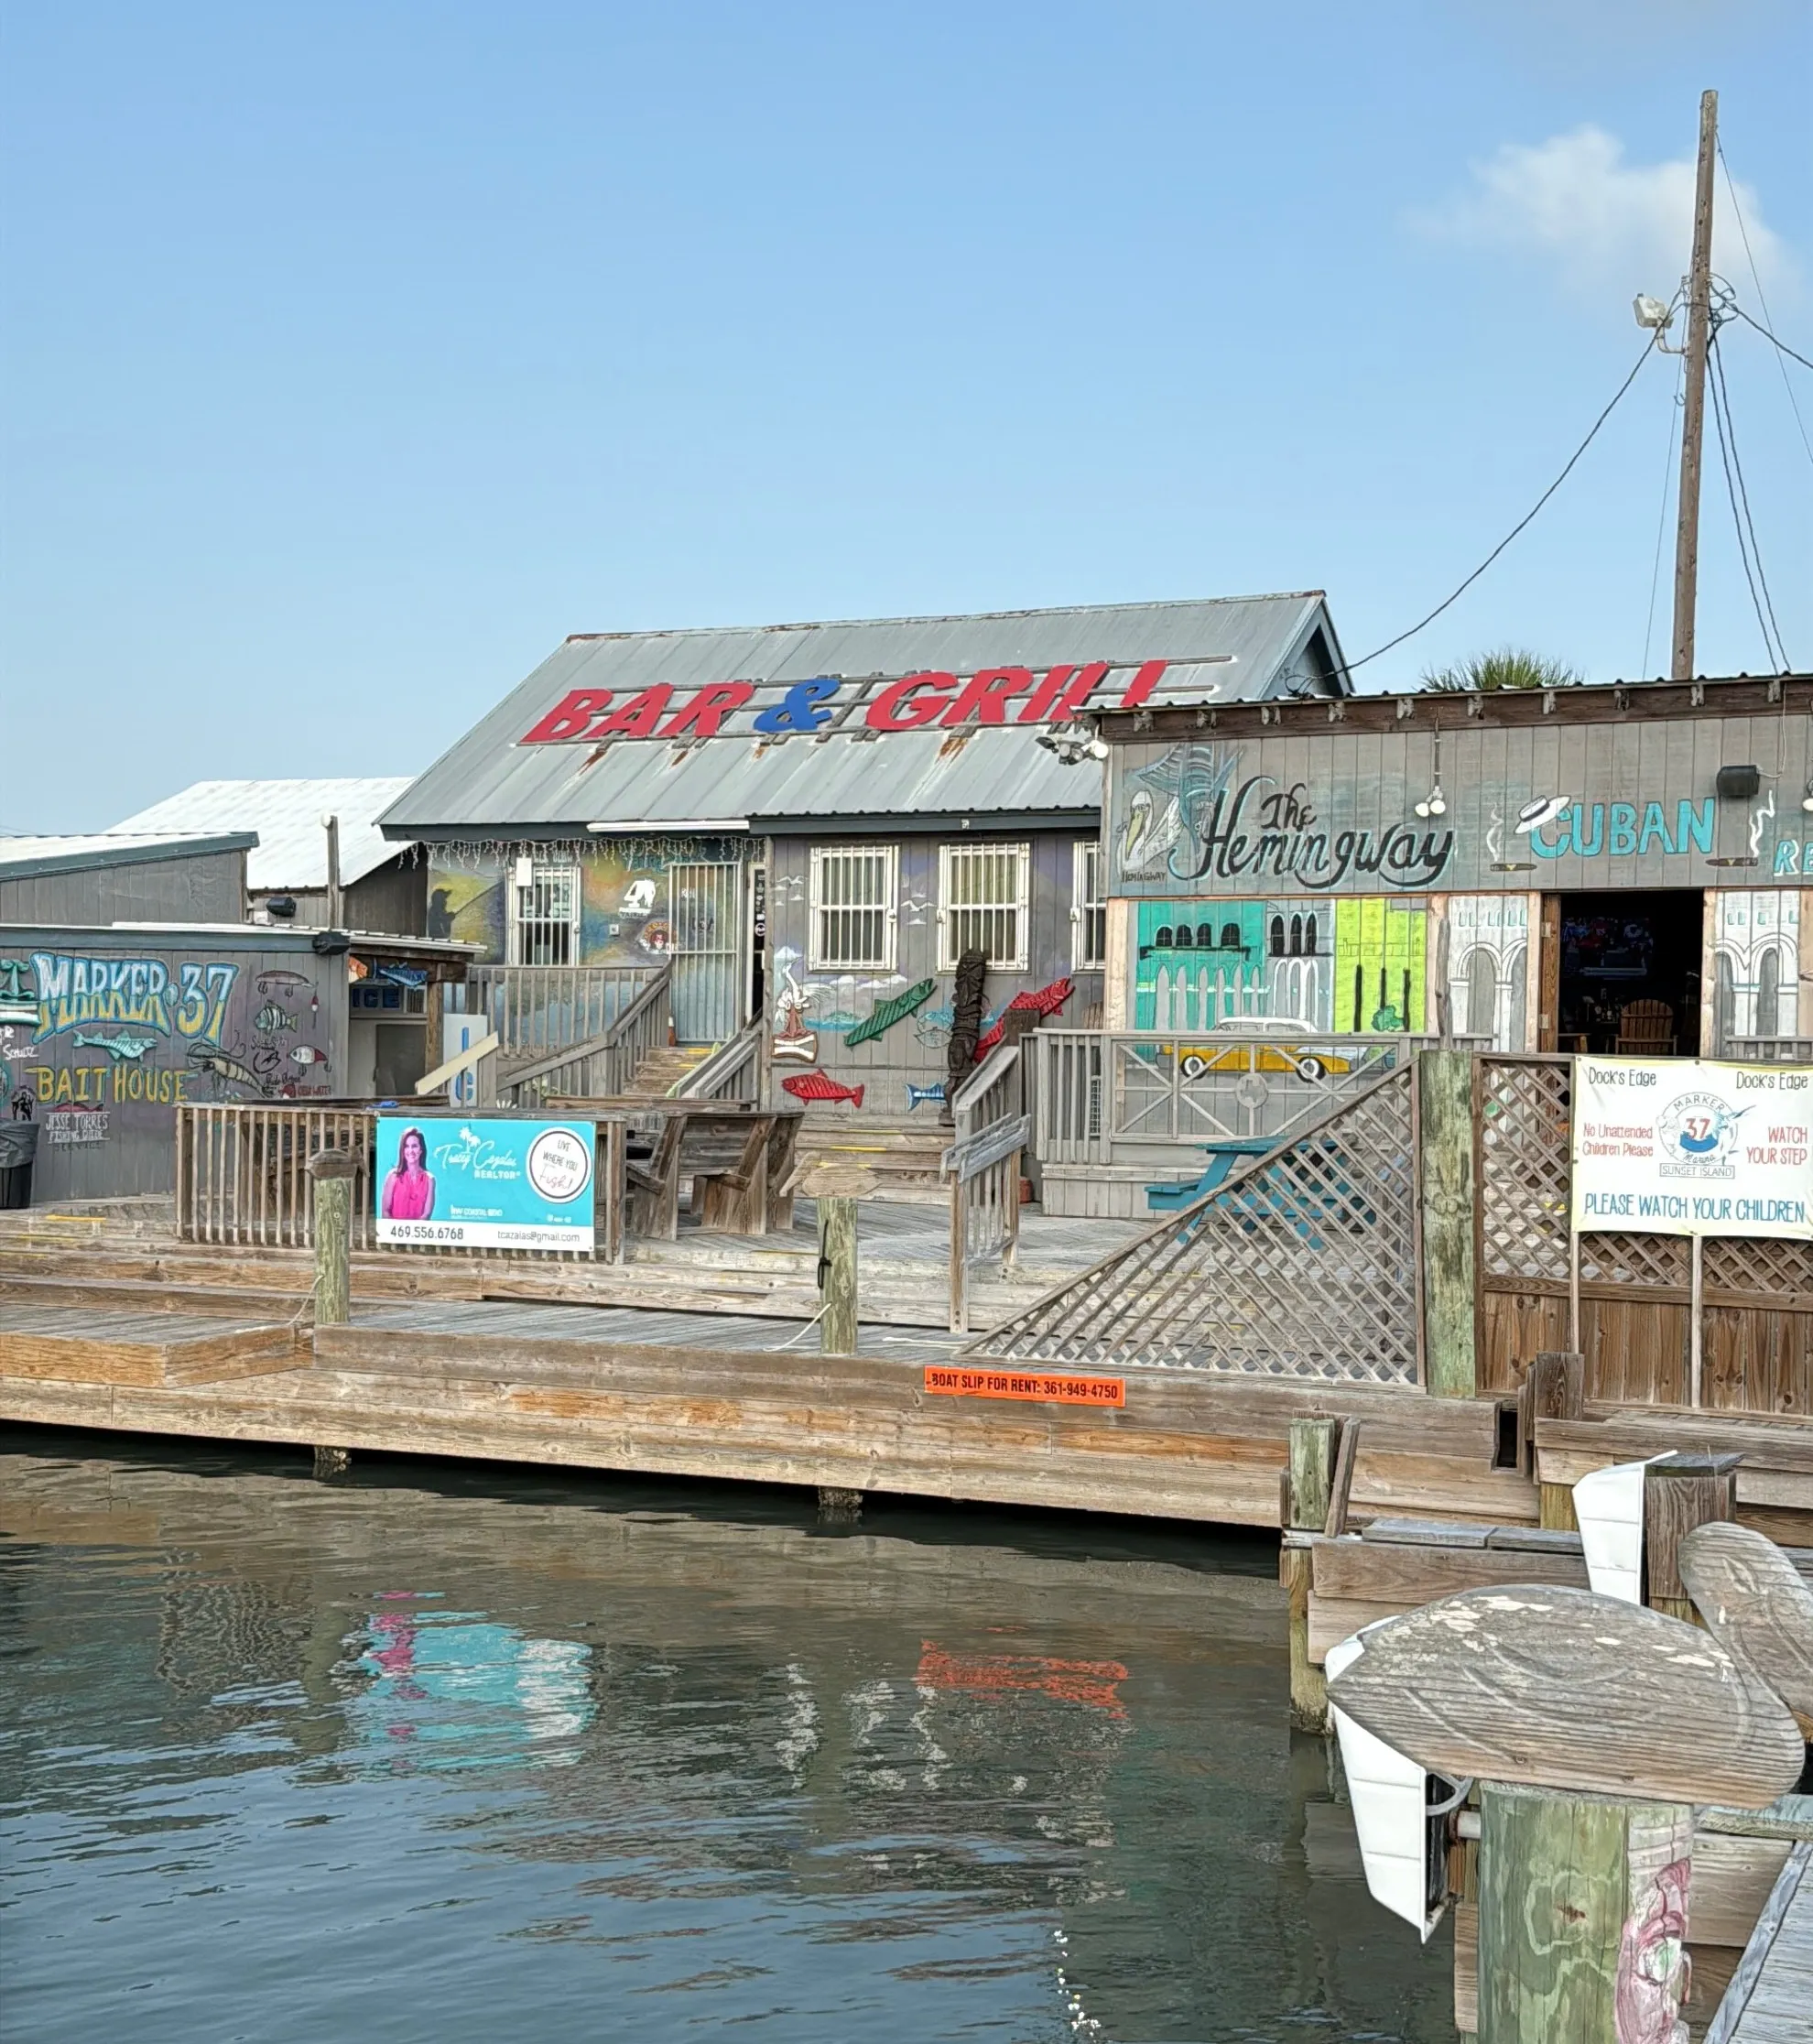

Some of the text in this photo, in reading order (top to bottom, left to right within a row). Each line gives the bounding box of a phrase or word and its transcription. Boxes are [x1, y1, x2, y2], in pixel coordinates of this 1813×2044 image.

[517, 659, 1170, 743] BAR & GRILL
[1261, 783, 1317, 829] The
[1167, 776, 1456, 890] Hemingway
[1530, 796, 1716, 858] CUBAN
[30, 951, 239, 1048] MARKER 37
[352, 988, 400, 1008] ICE
[24, 1062, 196, 1105] BAIT HOUSE
[1589, 1067, 1656, 1087] Dock's Edge
[1736, 1071, 1808, 1090] Dock's Edge
[1674, 1094, 1725, 1112] MARKER
[46, 1114, 108, 1131] JESSE TORRES
[1583, 1123, 1654, 1139] No Unattended
[1686, 1117, 1710, 1140] 37
[1768, 1126, 1808, 1144] WATCH
[557, 1139, 571, 1152] LIVE
[1582, 1142, 1621, 1157] Children
[1623, 1143, 1655, 1158] Please
[543, 1150, 579, 1172] WHERE YOU
[1746, 1147, 1808, 1166] YOUR STEP
[1662, 1164, 1732, 1178] SUNSET ISLAND
[1584, 1193, 1807, 1223] PLEASE WATCH YOUR CHILDREN
[390, 1225, 464, 1240] 469.556.6768
[931, 1373, 1118, 1399] BOAT SLIP FOR RENT: 361-949-4750
